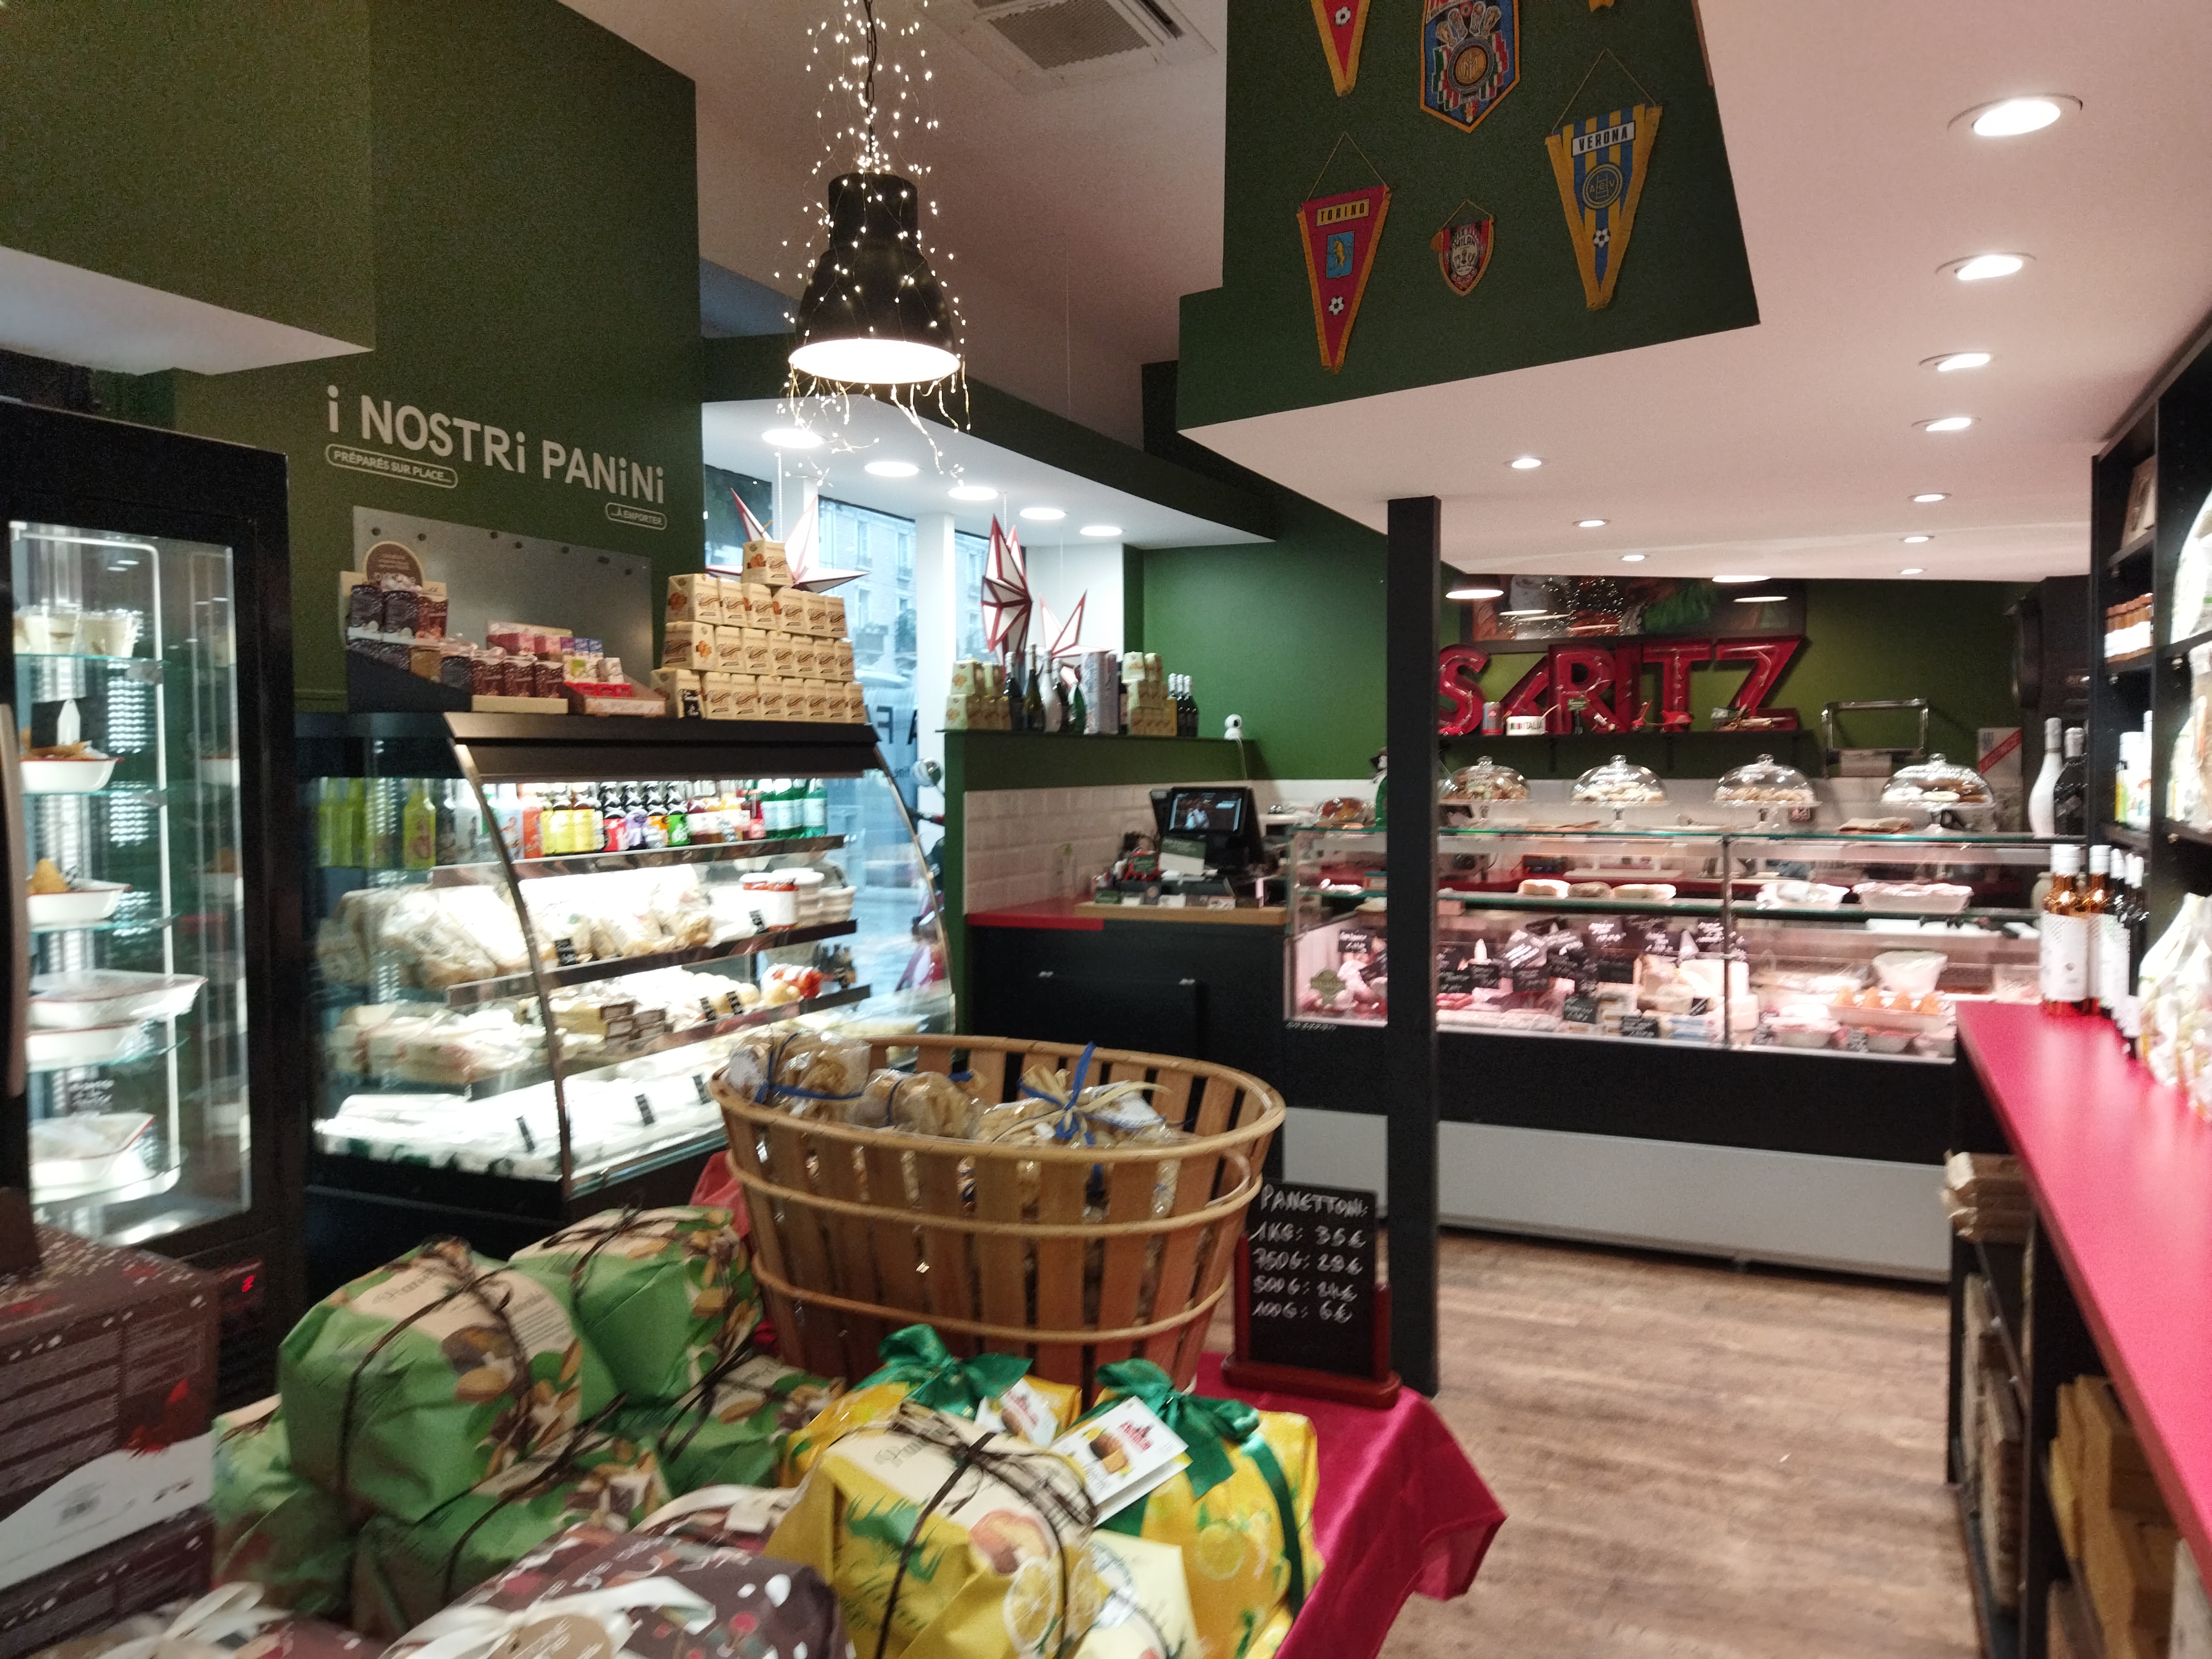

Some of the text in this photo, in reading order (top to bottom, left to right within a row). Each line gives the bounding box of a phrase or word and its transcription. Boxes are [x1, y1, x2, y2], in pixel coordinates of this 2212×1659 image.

[1579, 126, 1628, 152] VERONA
[1321, 202, 1365, 222] TORINO
[1455, 236, 1475, 249] MILAN
[333, 450, 389, 470] PRÉPARÉS
[390, 462, 411, 475] SUR
[1524, 721, 1543, 730] ITALIA
